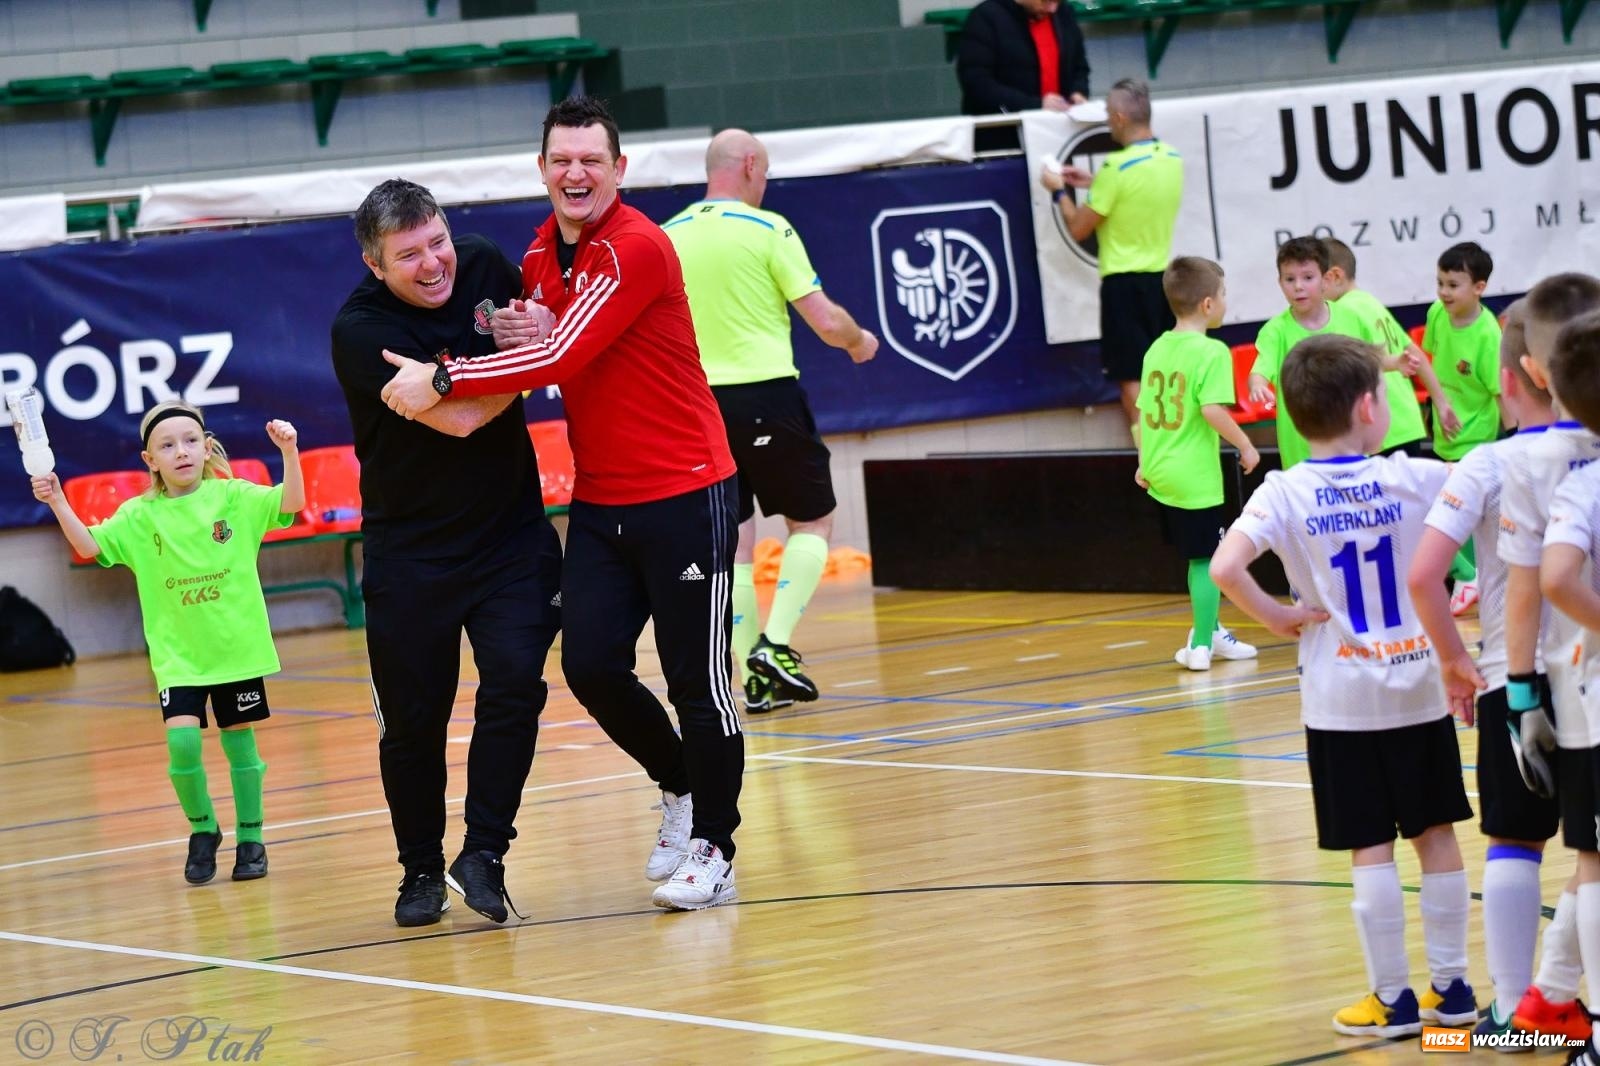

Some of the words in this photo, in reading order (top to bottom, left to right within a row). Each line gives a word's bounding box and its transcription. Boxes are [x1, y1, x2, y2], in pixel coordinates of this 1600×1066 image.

[1270, 83, 1600, 190] JUNIOR
[1145, 370, 1186, 431] 33
[1314, 481, 1383, 508] FORTECA
[153, 532, 162, 556] 9
[1330, 534, 1402, 635] 11
[236, 690, 261, 702] KKS
